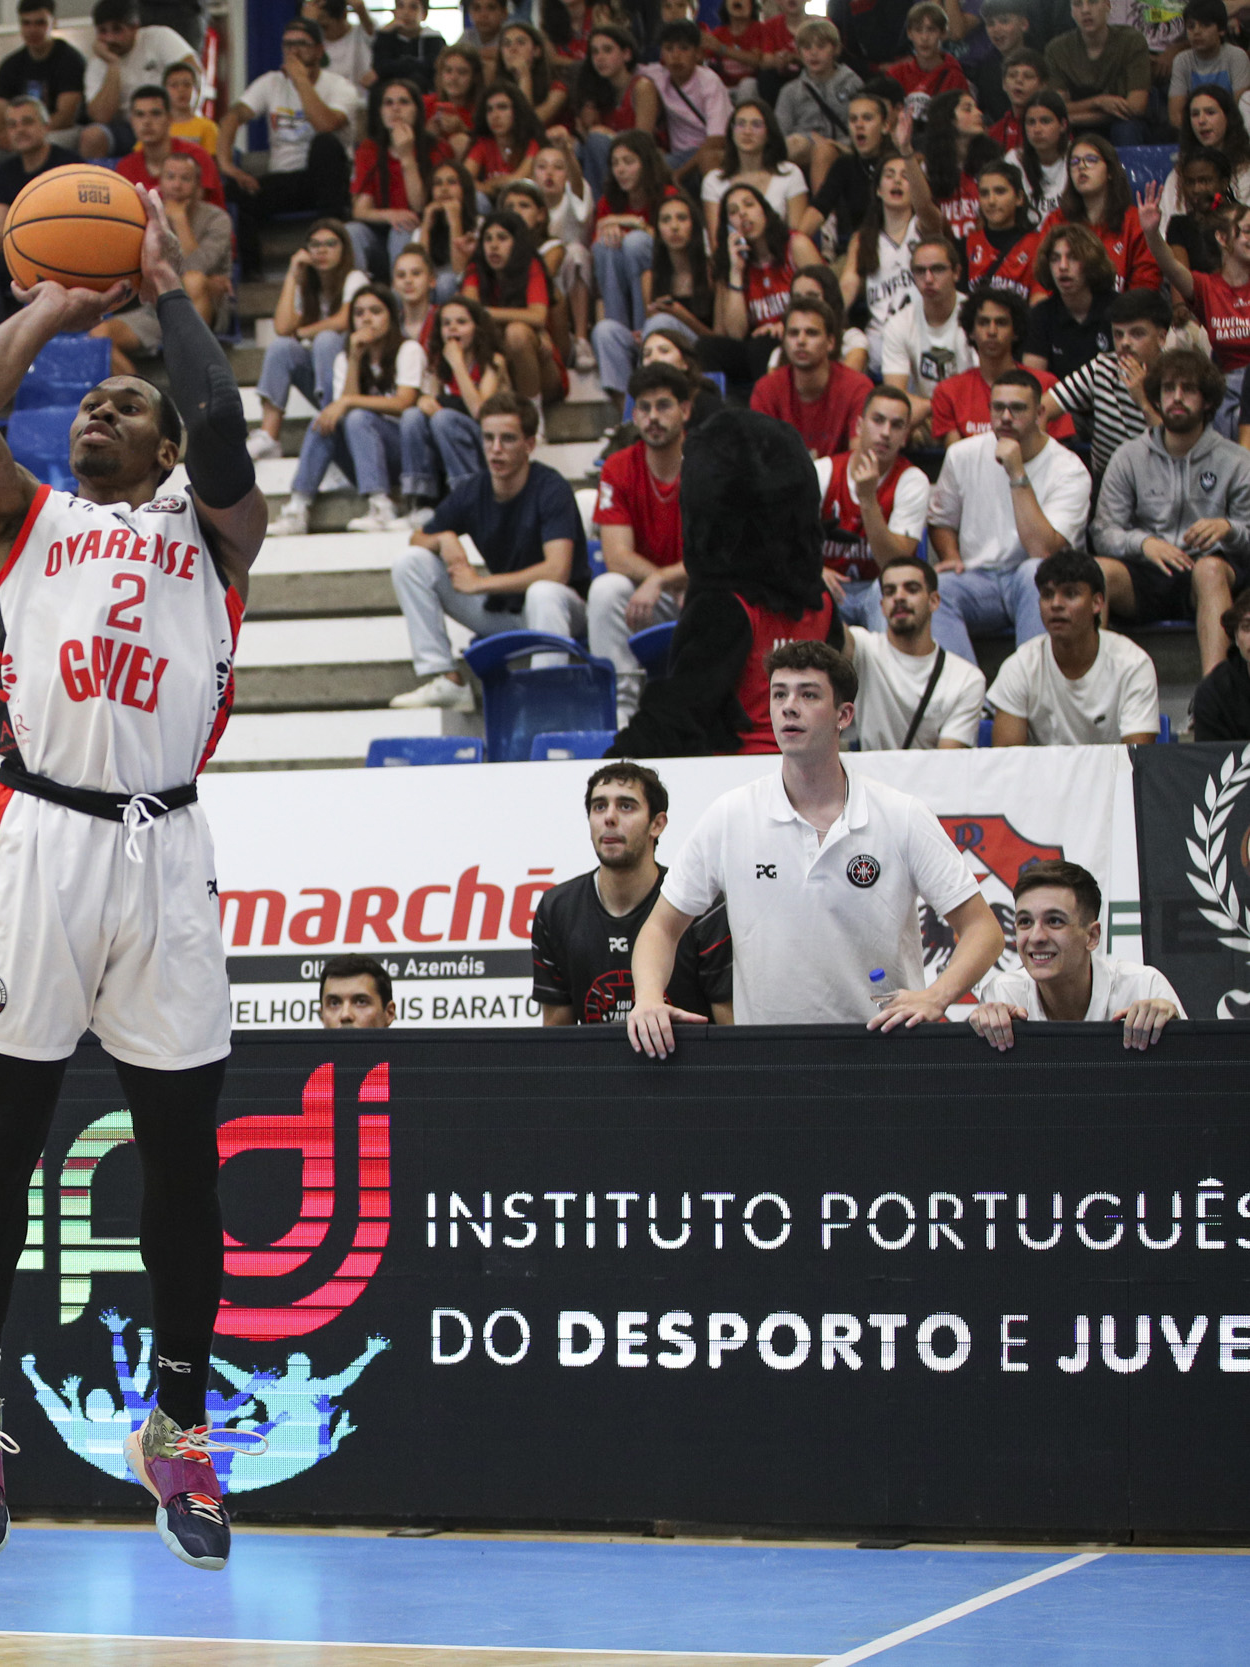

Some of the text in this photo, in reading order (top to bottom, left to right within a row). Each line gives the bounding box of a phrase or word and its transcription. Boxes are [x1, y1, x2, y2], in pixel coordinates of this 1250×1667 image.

[78, 190, 110, 205] FIBA
[44, 529, 200, 581] OVARENSE
[106, 573, 146, 633] 2
[60, 636, 169, 714] GAVEX
[756, 864, 777, 879] PG
[609, 937, 629, 952] PG
[404, 955, 485, 977] Azeméis
[433, 994, 541, 1020] BARATO
[427, 1191, 792, 1250] INSTITUTO
[431, 1307, 1250, 1374] DO DESPORTO E JUVE
